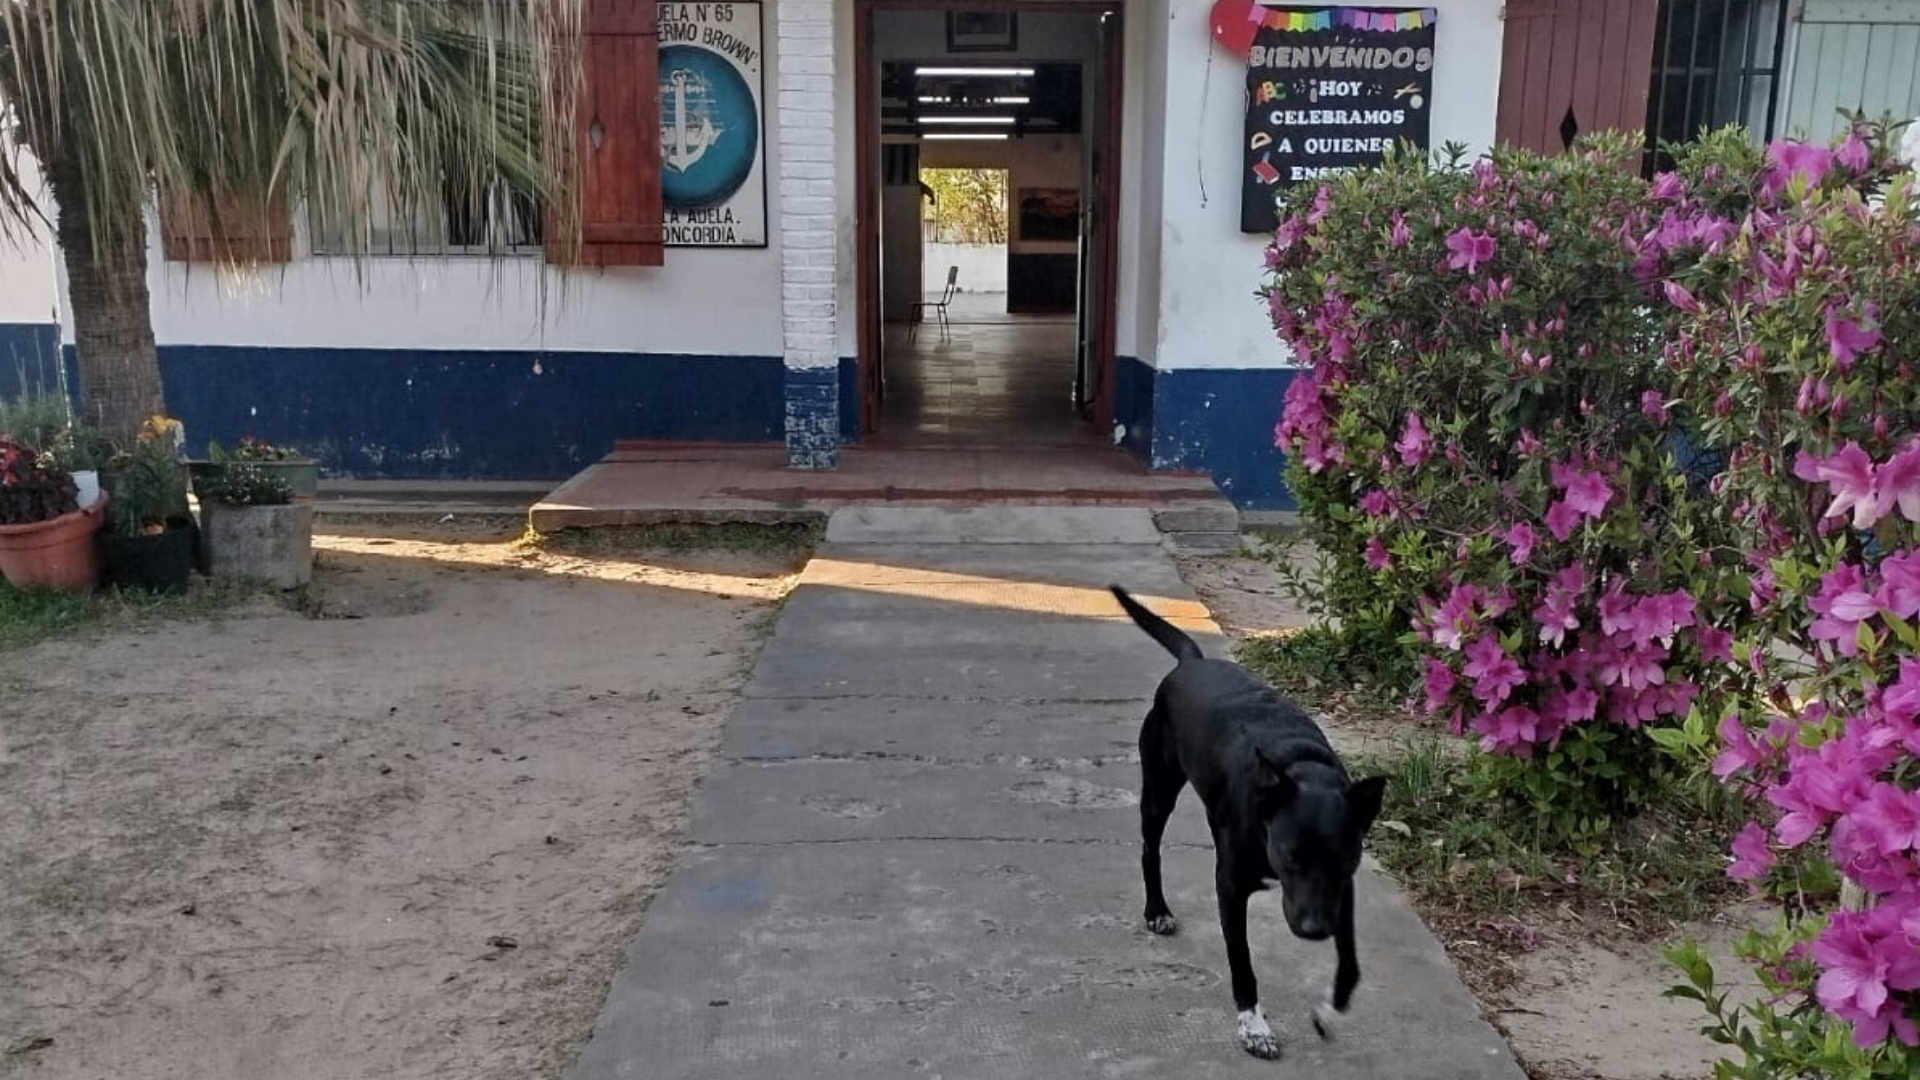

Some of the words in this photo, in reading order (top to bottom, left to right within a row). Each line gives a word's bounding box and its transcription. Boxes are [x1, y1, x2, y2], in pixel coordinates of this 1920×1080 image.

[715, 4, 734, 22] 65
[1250, 45, 1434, 72] BIENVENIDOS
[1270, 109, 1406, 125] CELEBRAMOS
[1278, 137, 1293, 153] A
[1304, 137, 1395, 154] QUIENES
